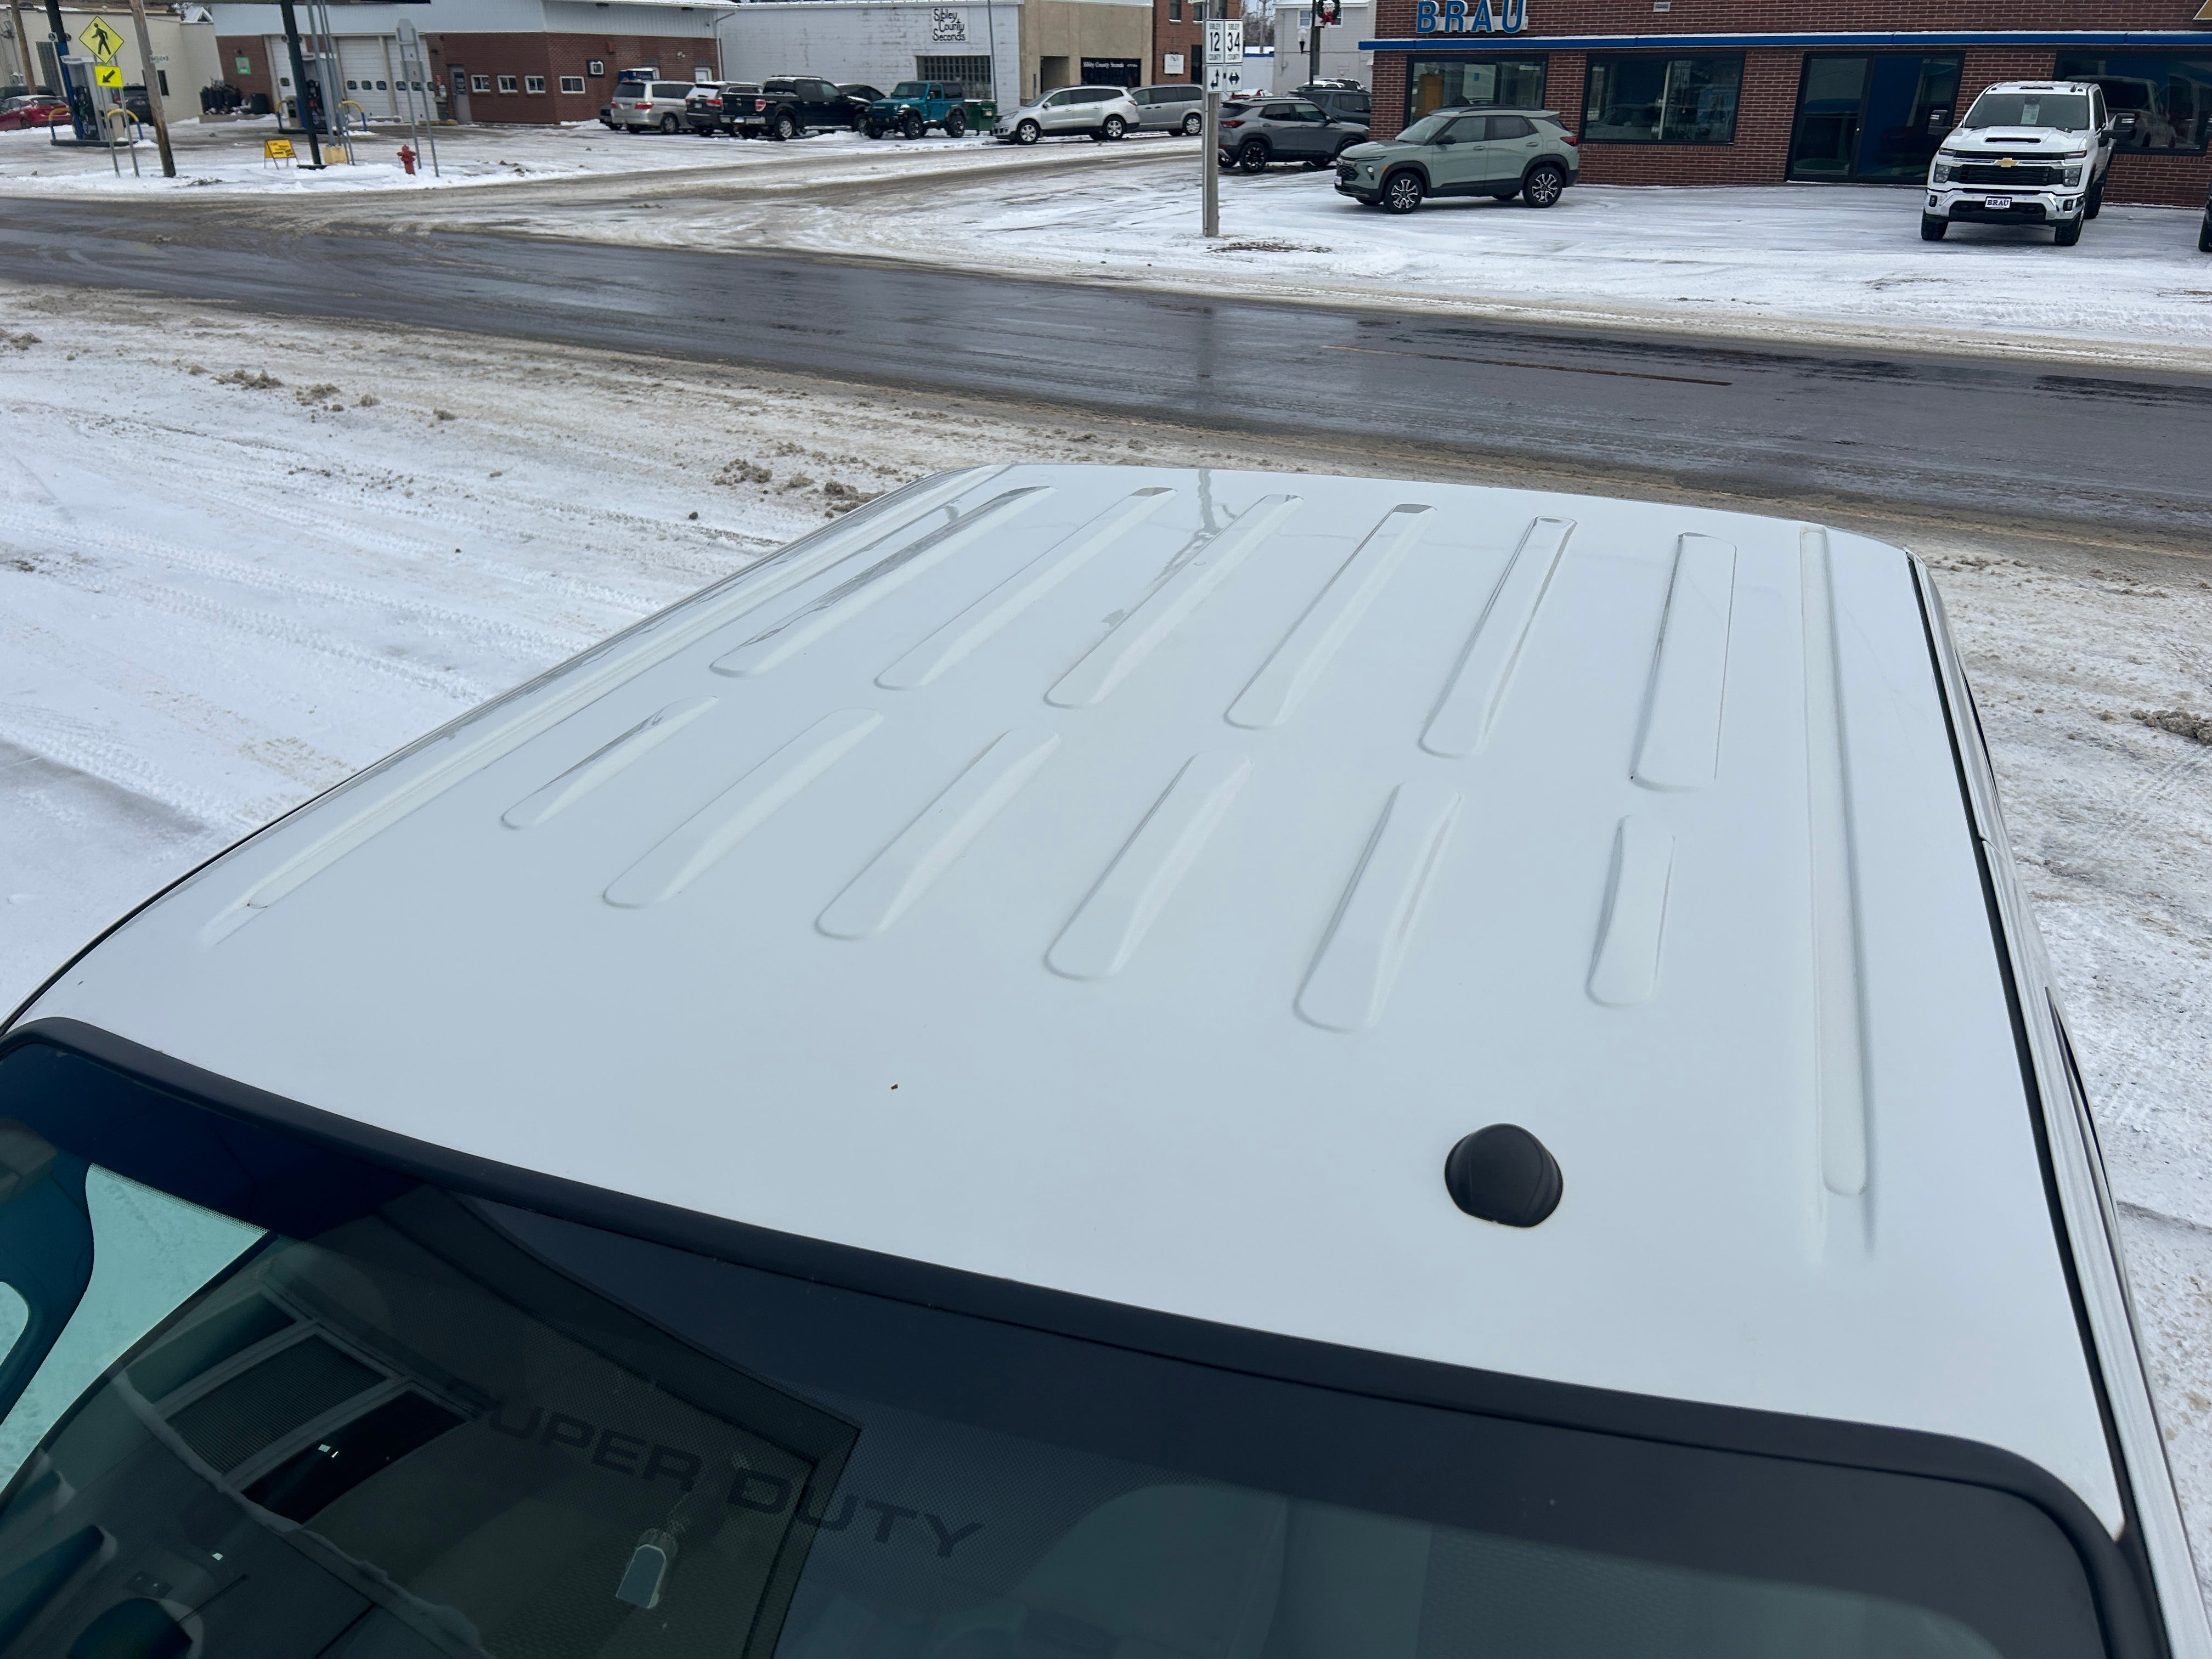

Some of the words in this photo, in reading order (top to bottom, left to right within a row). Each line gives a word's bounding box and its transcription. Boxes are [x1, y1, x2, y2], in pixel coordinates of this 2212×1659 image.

[933, 8, 958, 23] Sibley
[1416, 0, 1525, 33] BRAU
[933, 29, 966, 41] Seconds
[939, 19, 964, 33] County
[1210, 32, 1220, 52] 12
[1227, 32, 1240, 52] 34
[726, 1466, 985, 1559] DUTY
